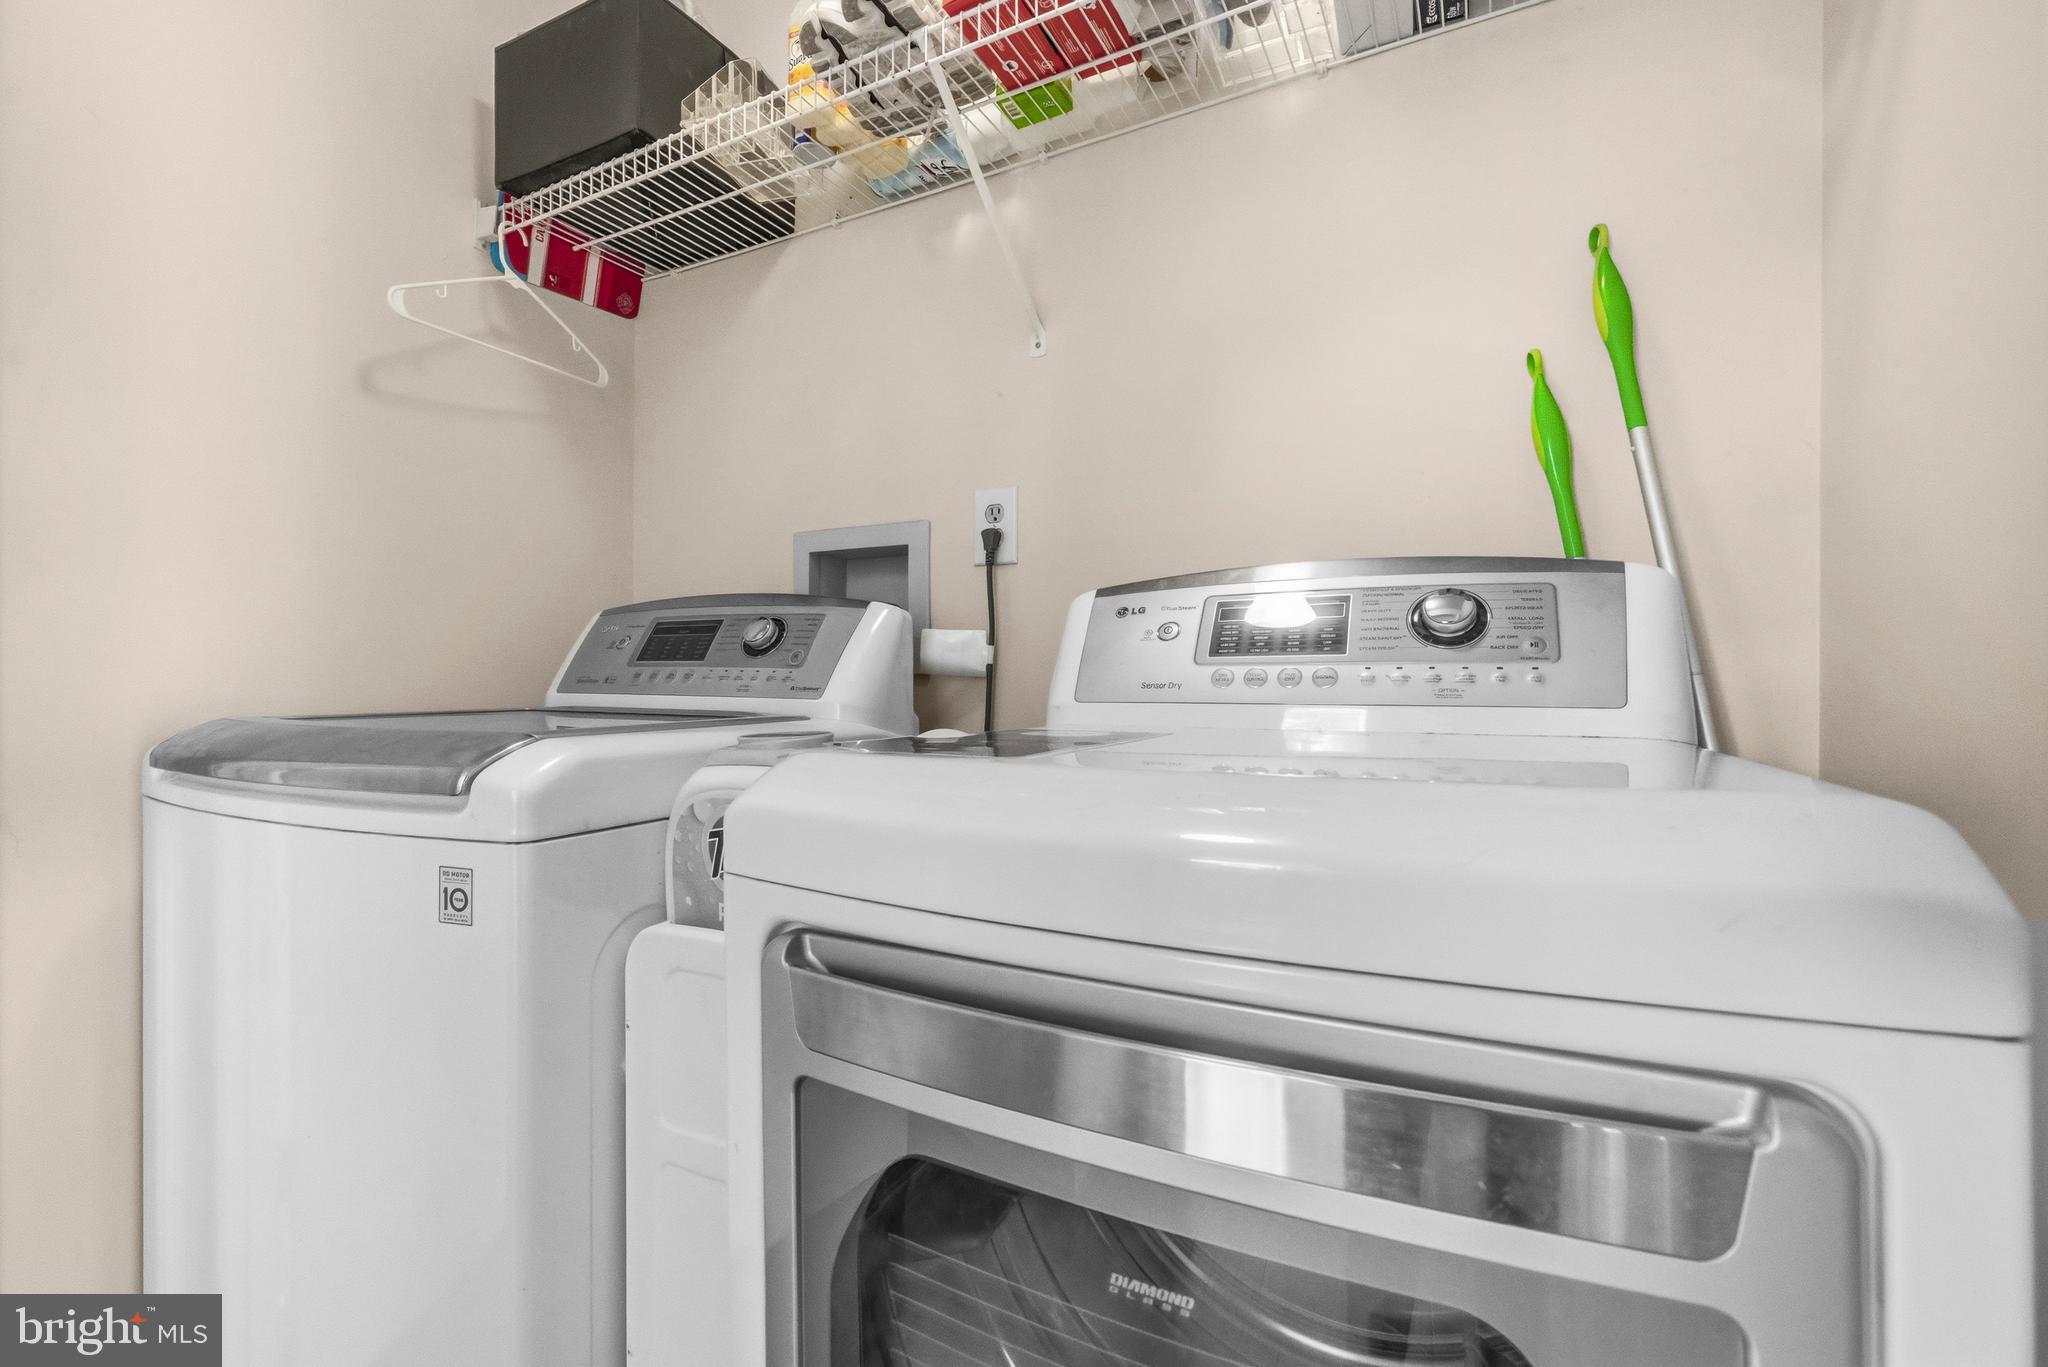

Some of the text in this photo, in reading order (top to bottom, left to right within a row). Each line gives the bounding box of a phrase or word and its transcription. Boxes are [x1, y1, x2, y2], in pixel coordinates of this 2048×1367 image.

[1131, 606, 1146, 615] LG
[1140, 682, 1183, 691] Sensor Dry
[443, 887, 469, 913] 10
[1110, 1272, 1195, 1310] DIAMOND
